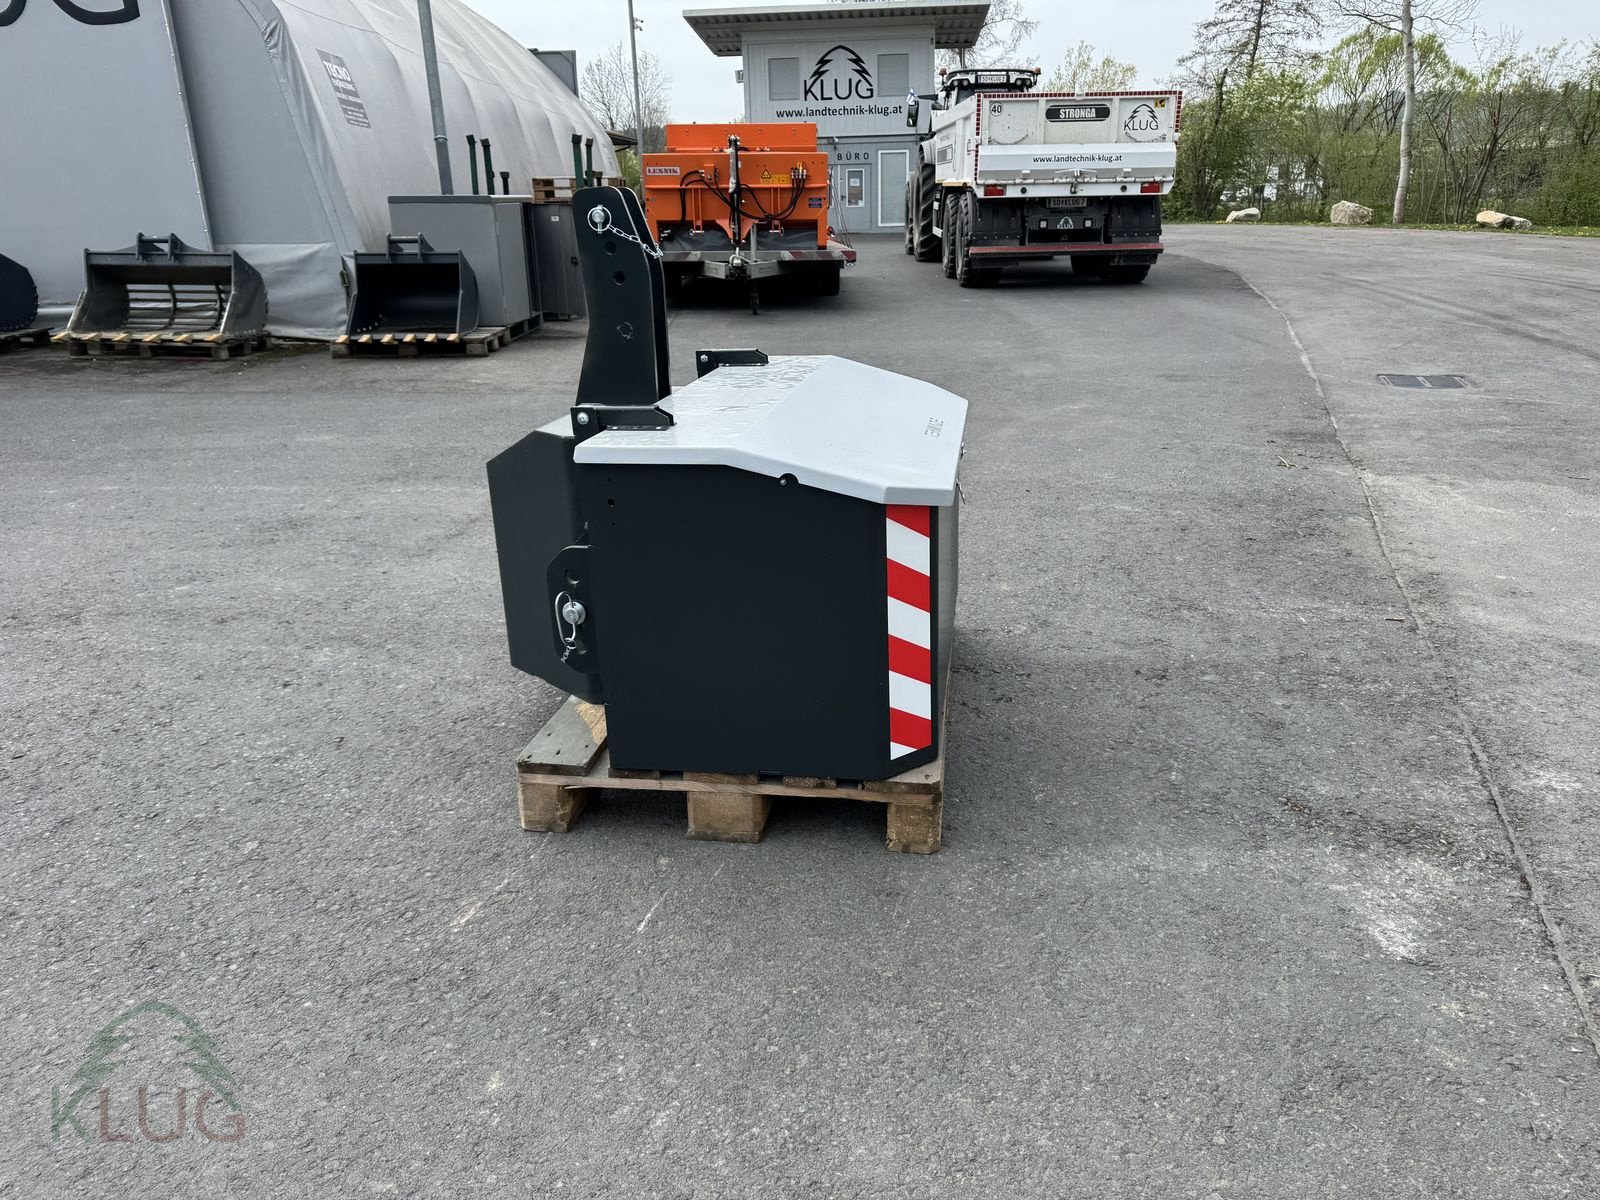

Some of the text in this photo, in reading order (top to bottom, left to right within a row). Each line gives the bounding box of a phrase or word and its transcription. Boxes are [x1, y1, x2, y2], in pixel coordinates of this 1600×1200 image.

[804, 78, 874, 101] KLUG
[775, 104, 903, 118] www.landtechnik-klug.at
[991, 104, 1002, 114] 40
[1059, 108, 1096, 119] STRONGA
[1123, 119, 1159, 131] KLUG
[837, 151, 870, 161] BÜRO
[1032, 154, 1123, 163] www.landtechnik-klug.at
